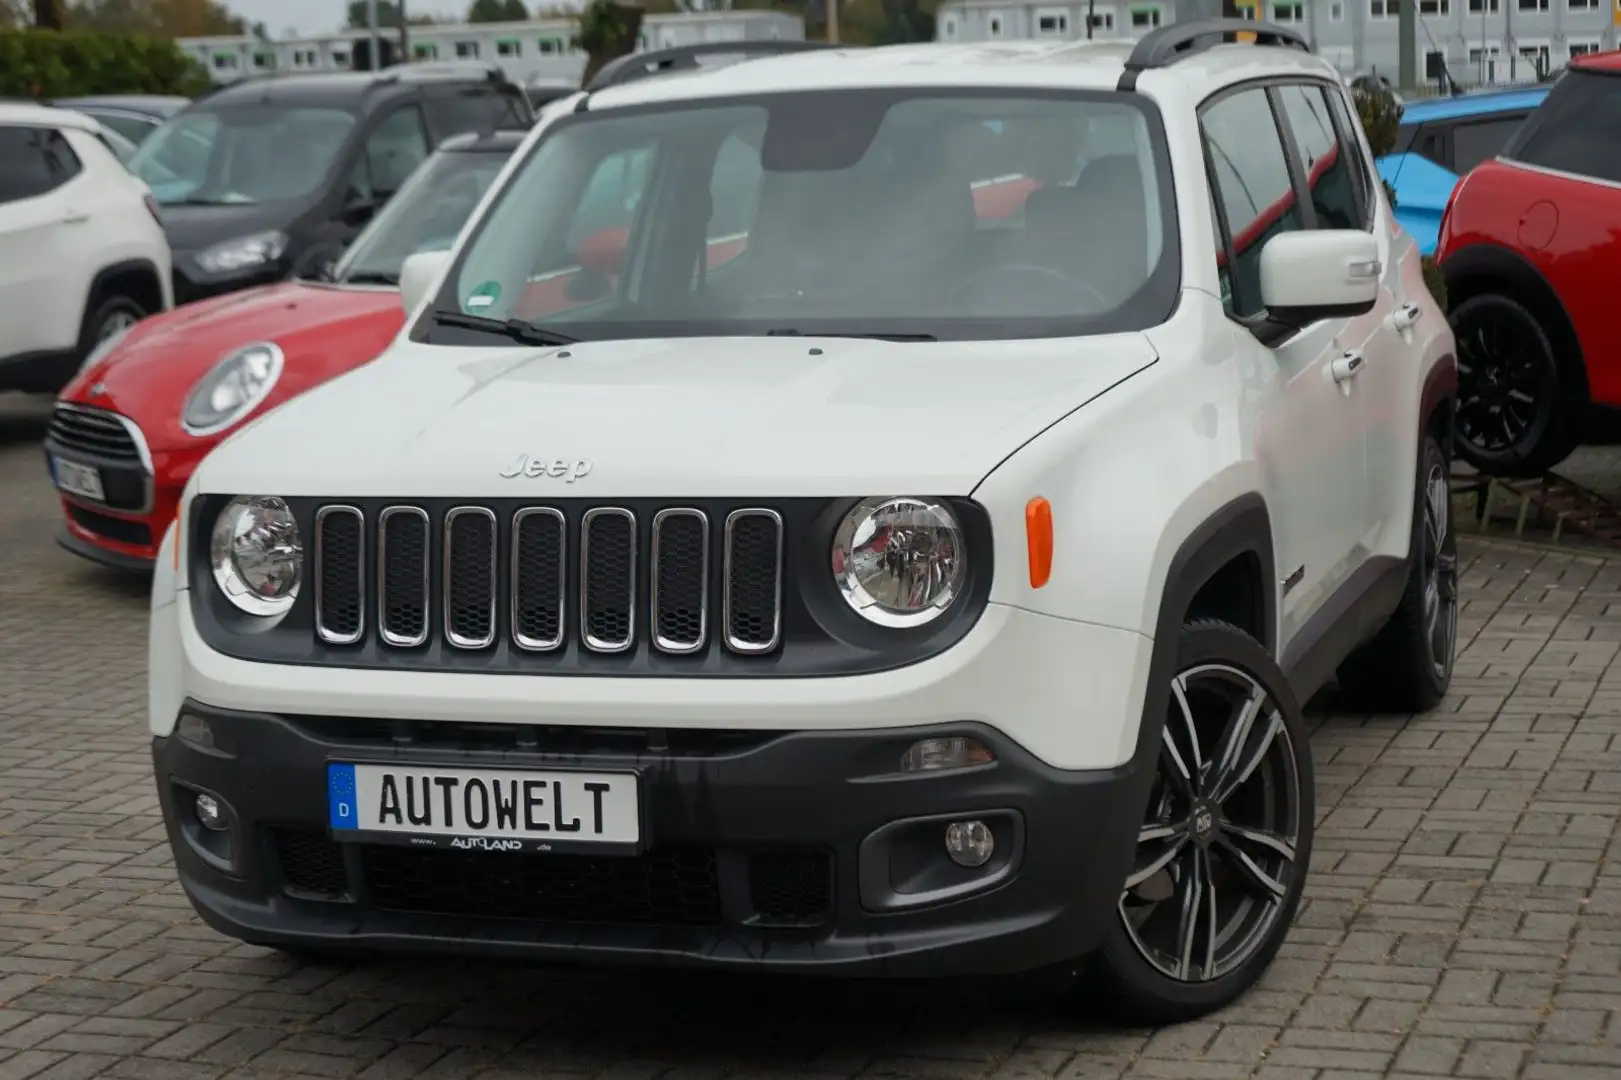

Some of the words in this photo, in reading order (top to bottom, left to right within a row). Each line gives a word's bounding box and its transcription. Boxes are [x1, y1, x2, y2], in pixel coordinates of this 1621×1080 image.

[500, 453, 593, 483] Jeep
[339, 803, 349, 817] D
[379, 774, 610, 834] AUTOWELT
[450, 837, 523, 851] AUTOLAND
